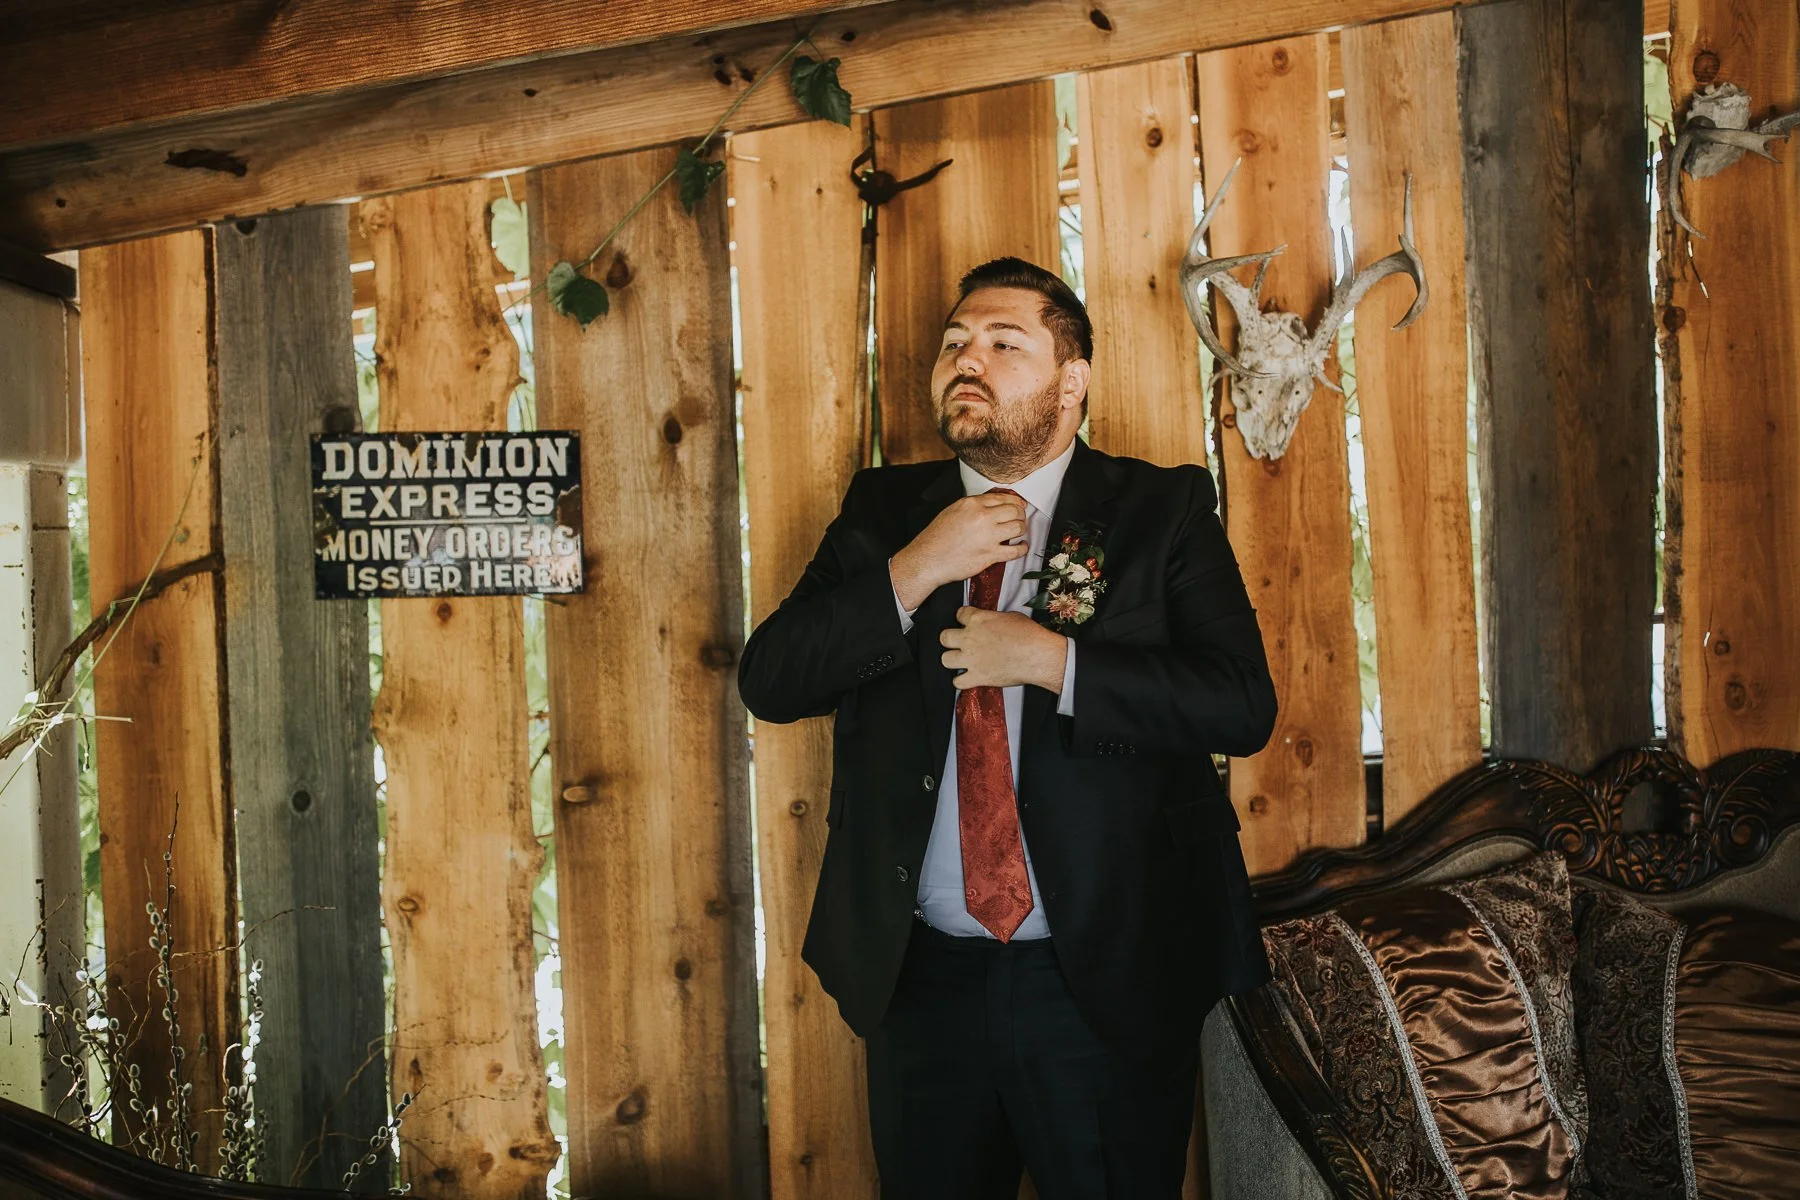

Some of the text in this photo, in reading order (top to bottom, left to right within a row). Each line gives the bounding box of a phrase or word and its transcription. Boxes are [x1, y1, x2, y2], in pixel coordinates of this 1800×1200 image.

[321, 438, 570, 481] DOMINION
[341, 482, 555, 519] EXPRESS
[322, 524, 575, 562] MONEY ORDERS
[347, 560, 553, 592] ISSUED HERE
